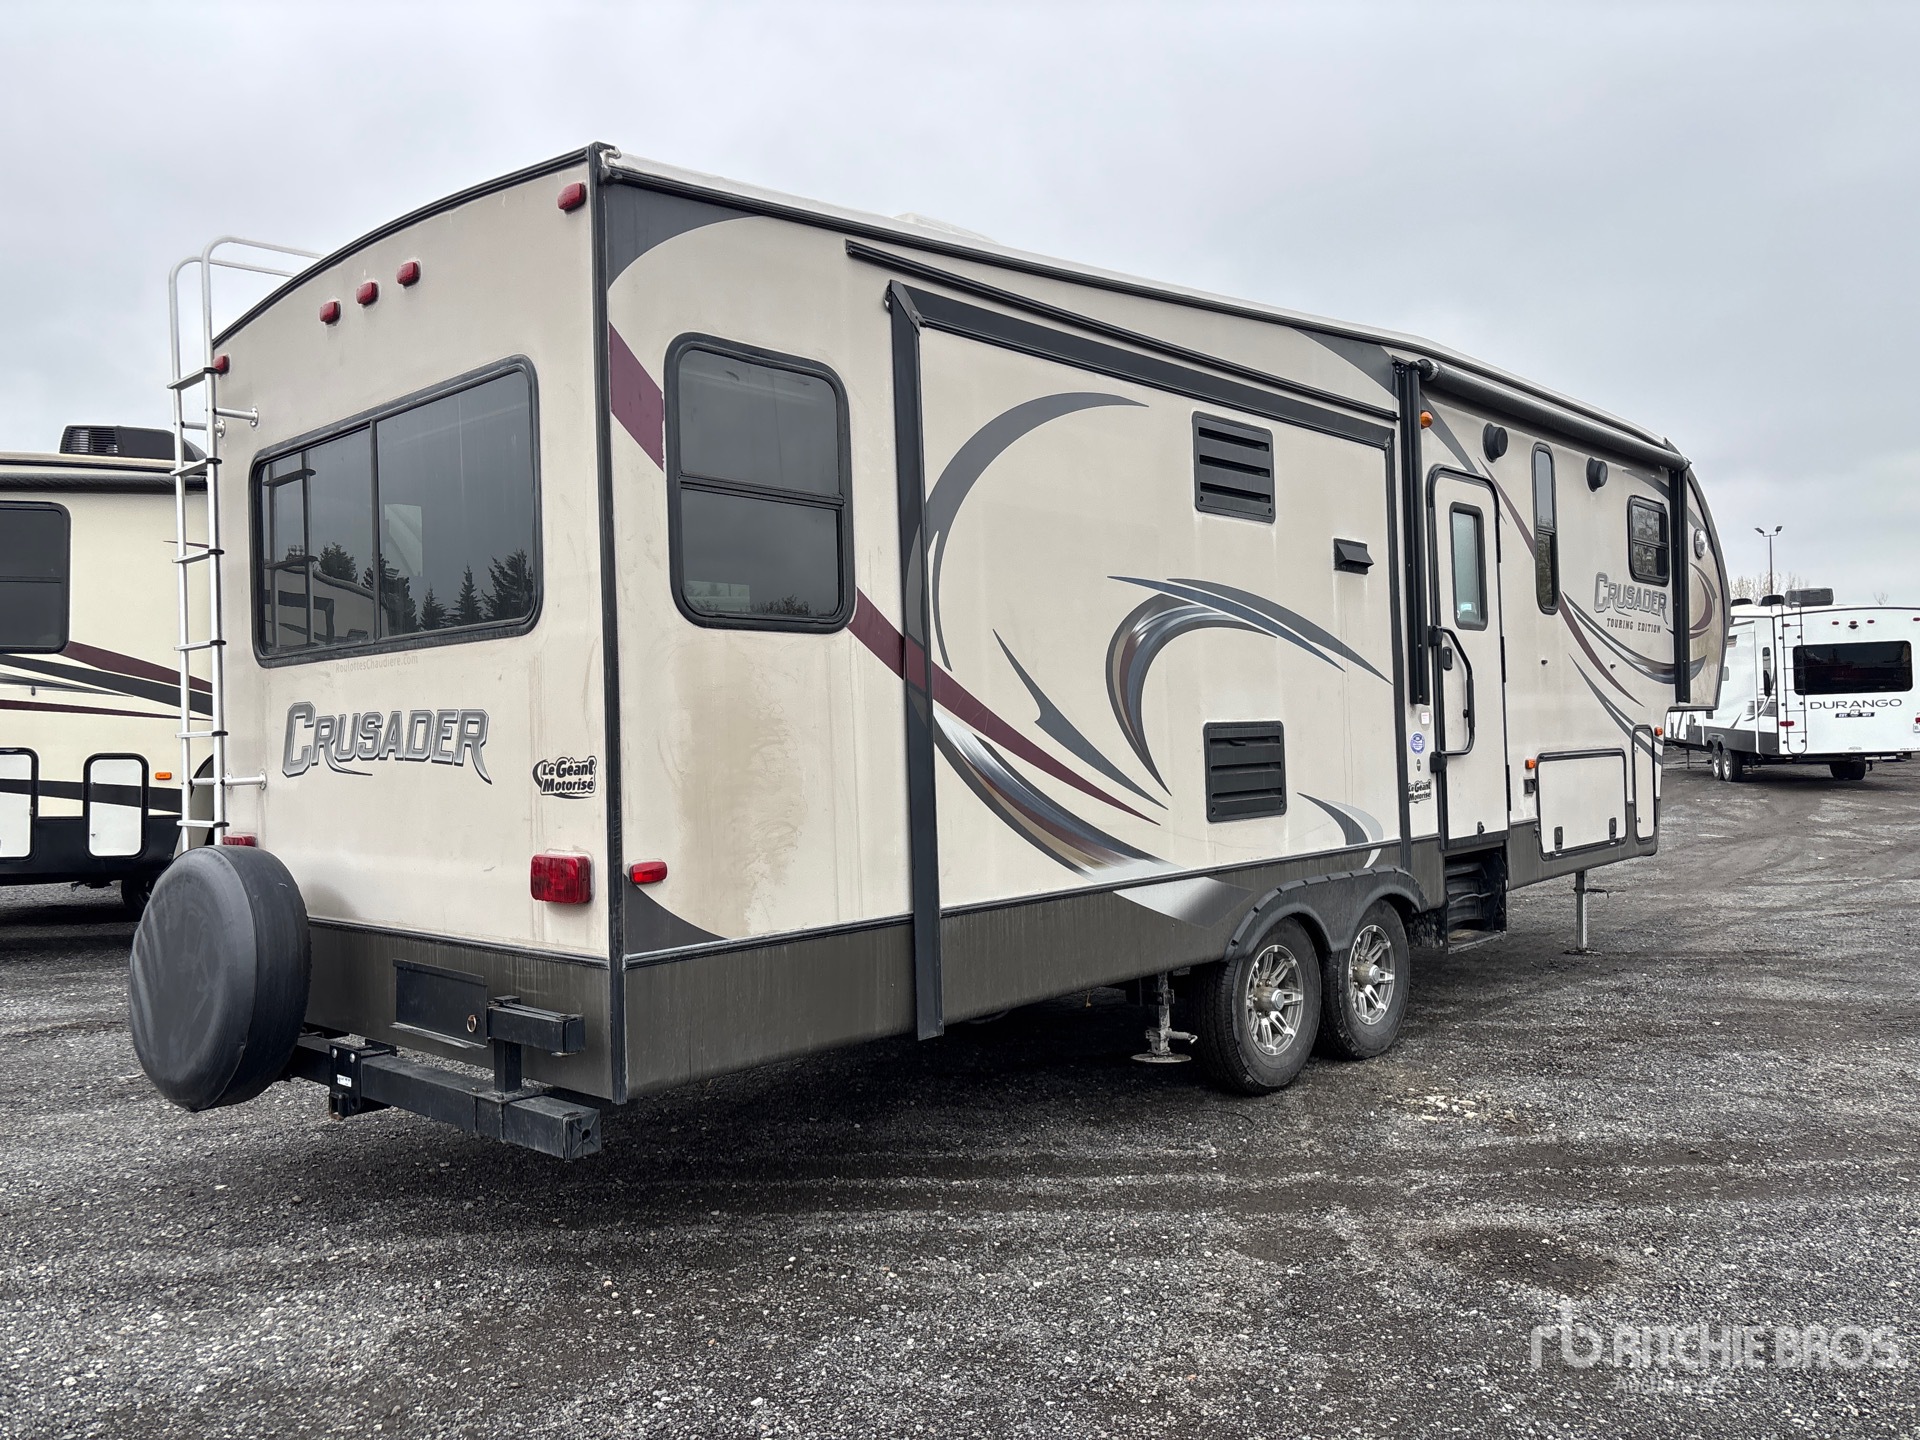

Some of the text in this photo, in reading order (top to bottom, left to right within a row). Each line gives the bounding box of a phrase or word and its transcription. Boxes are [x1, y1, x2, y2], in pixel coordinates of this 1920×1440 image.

[1594, 571, 1668, 625] CRUSADER
[1606, 617, 1661, 634] TOURING EDITION
[1809, 698, 1903, 710] DURANGO
[281, 701, 493, 785] CRUSADER
[542, 759, 595, 779] Le Géant
[542, 776, 594, 792] Motorisé
